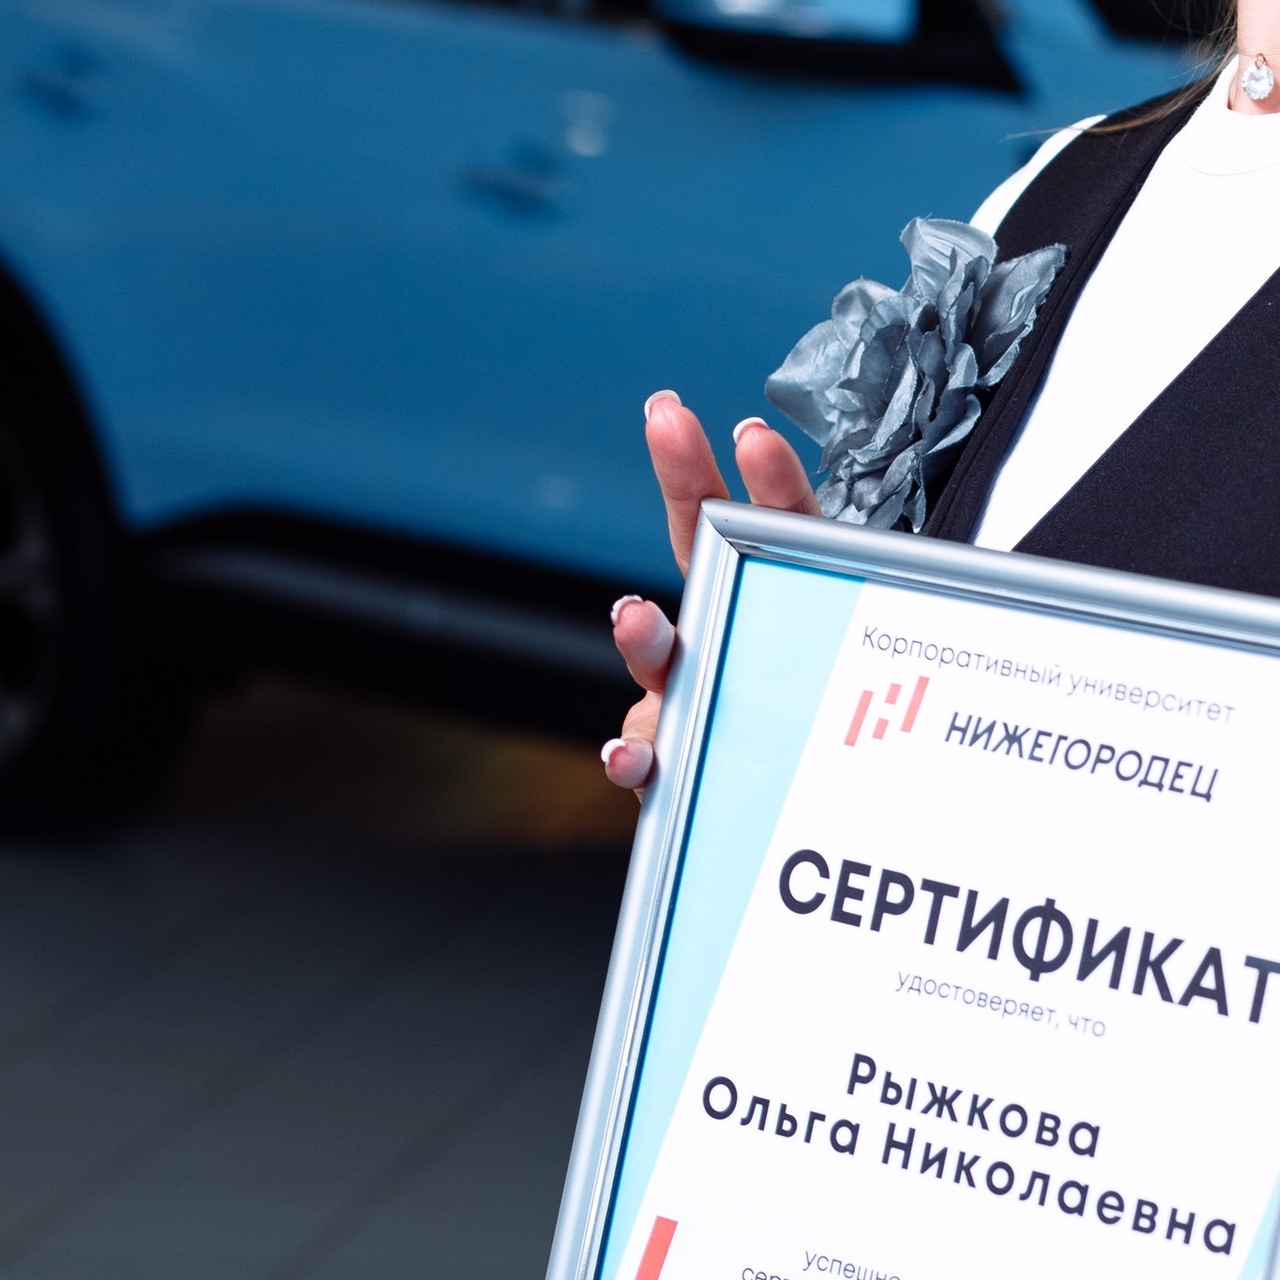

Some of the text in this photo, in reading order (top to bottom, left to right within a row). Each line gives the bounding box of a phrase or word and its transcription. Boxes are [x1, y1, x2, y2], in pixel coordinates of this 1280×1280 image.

[862, 625, 1236, 724] Корпоративный университет
[945, 711, 1219, 803] НИЖЕГОРОДЕЦ
[895, 971, 1106, 1038] удостоверяет, что
[846, 1052, 1101, 1158] Рыжкова
[701, 1075, 1237, 1256] Ольга Николаевна
